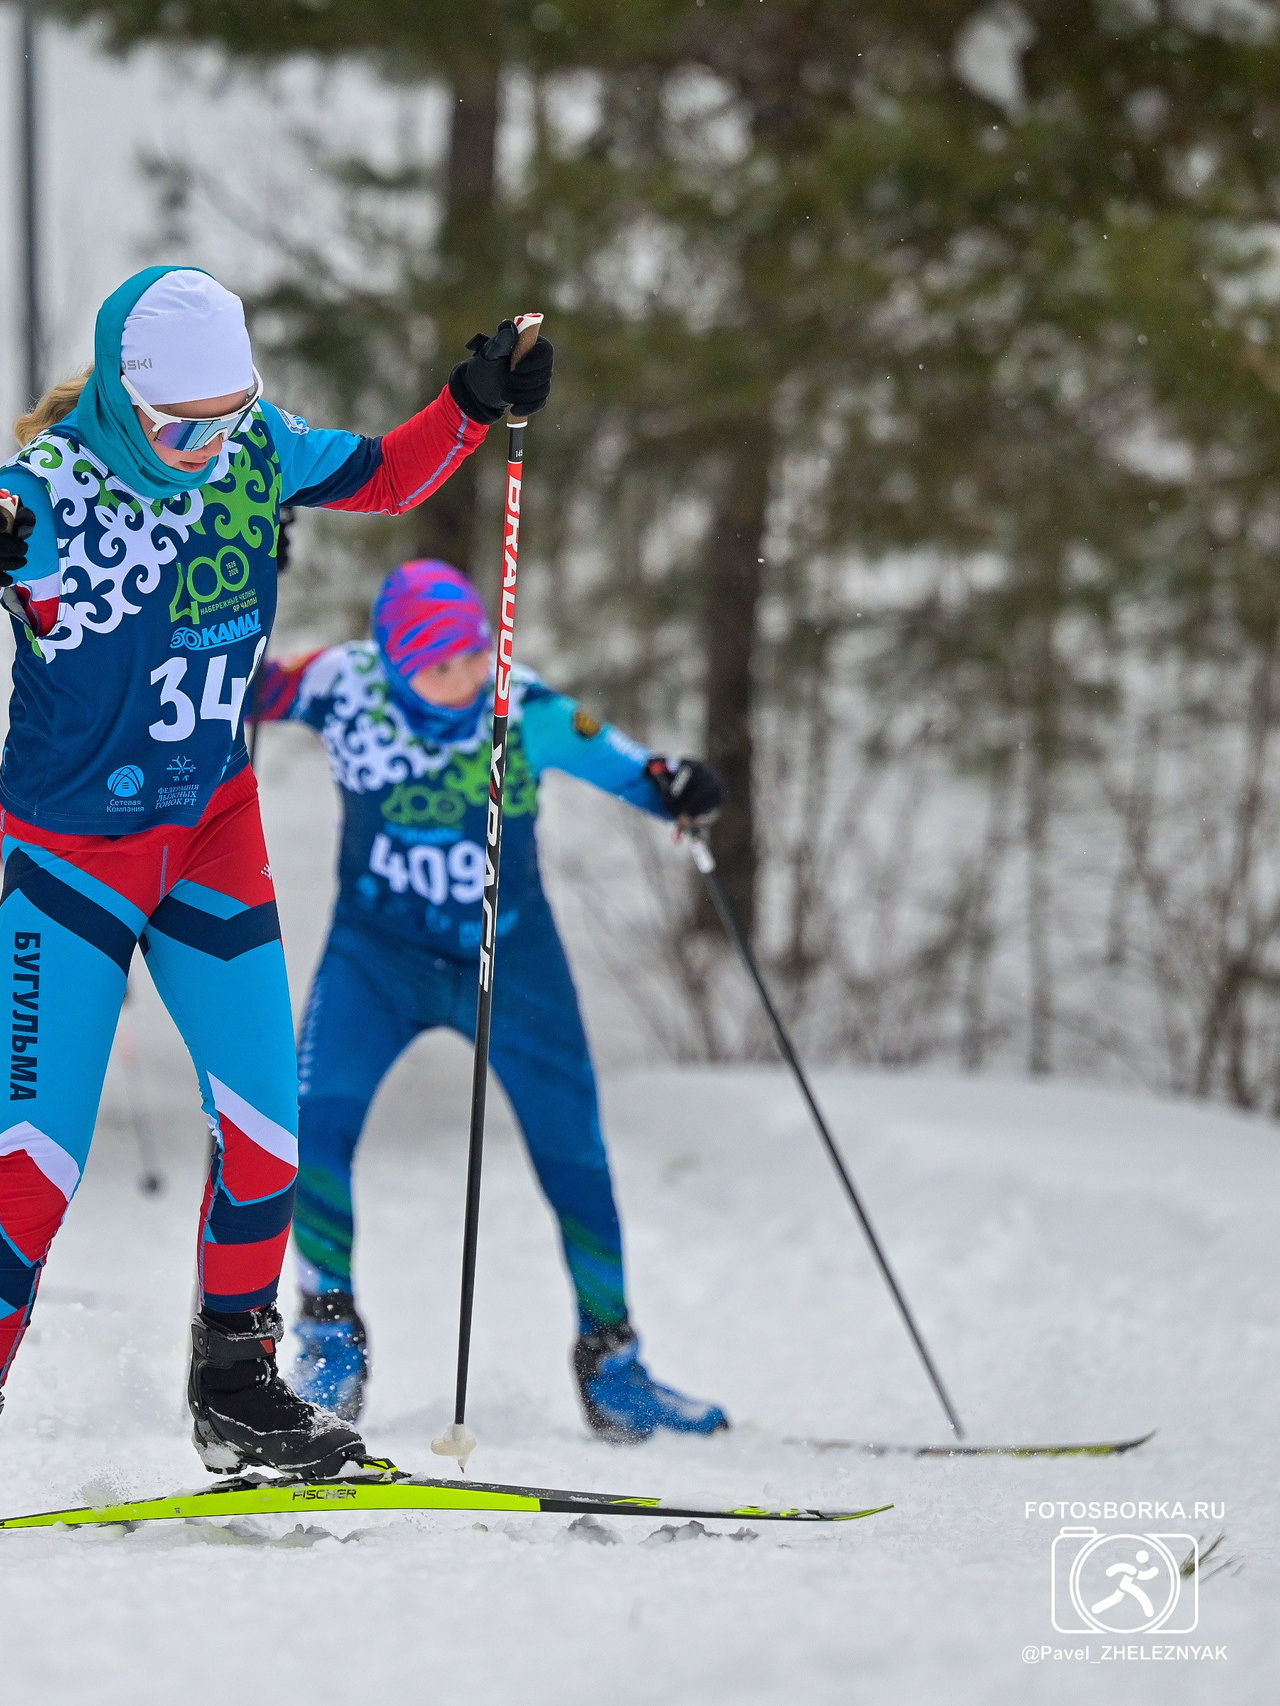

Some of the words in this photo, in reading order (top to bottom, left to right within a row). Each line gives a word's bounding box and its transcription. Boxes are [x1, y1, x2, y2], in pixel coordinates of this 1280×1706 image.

[169, 545, 250, 625] 400
[200, 596, 239, 616] НАБЕРЕЖНЫЕ
[202, 609, 261, 647] KAMAZ
[155, 798, 183, 810] ГОНОК
[183, 798, 197, 806] РТ
[369, 833, 486, 905] 409
[10, 931, 42, 1101] БУГУЛЬМА
[292, 1488, 357, 1500] FISCHER
